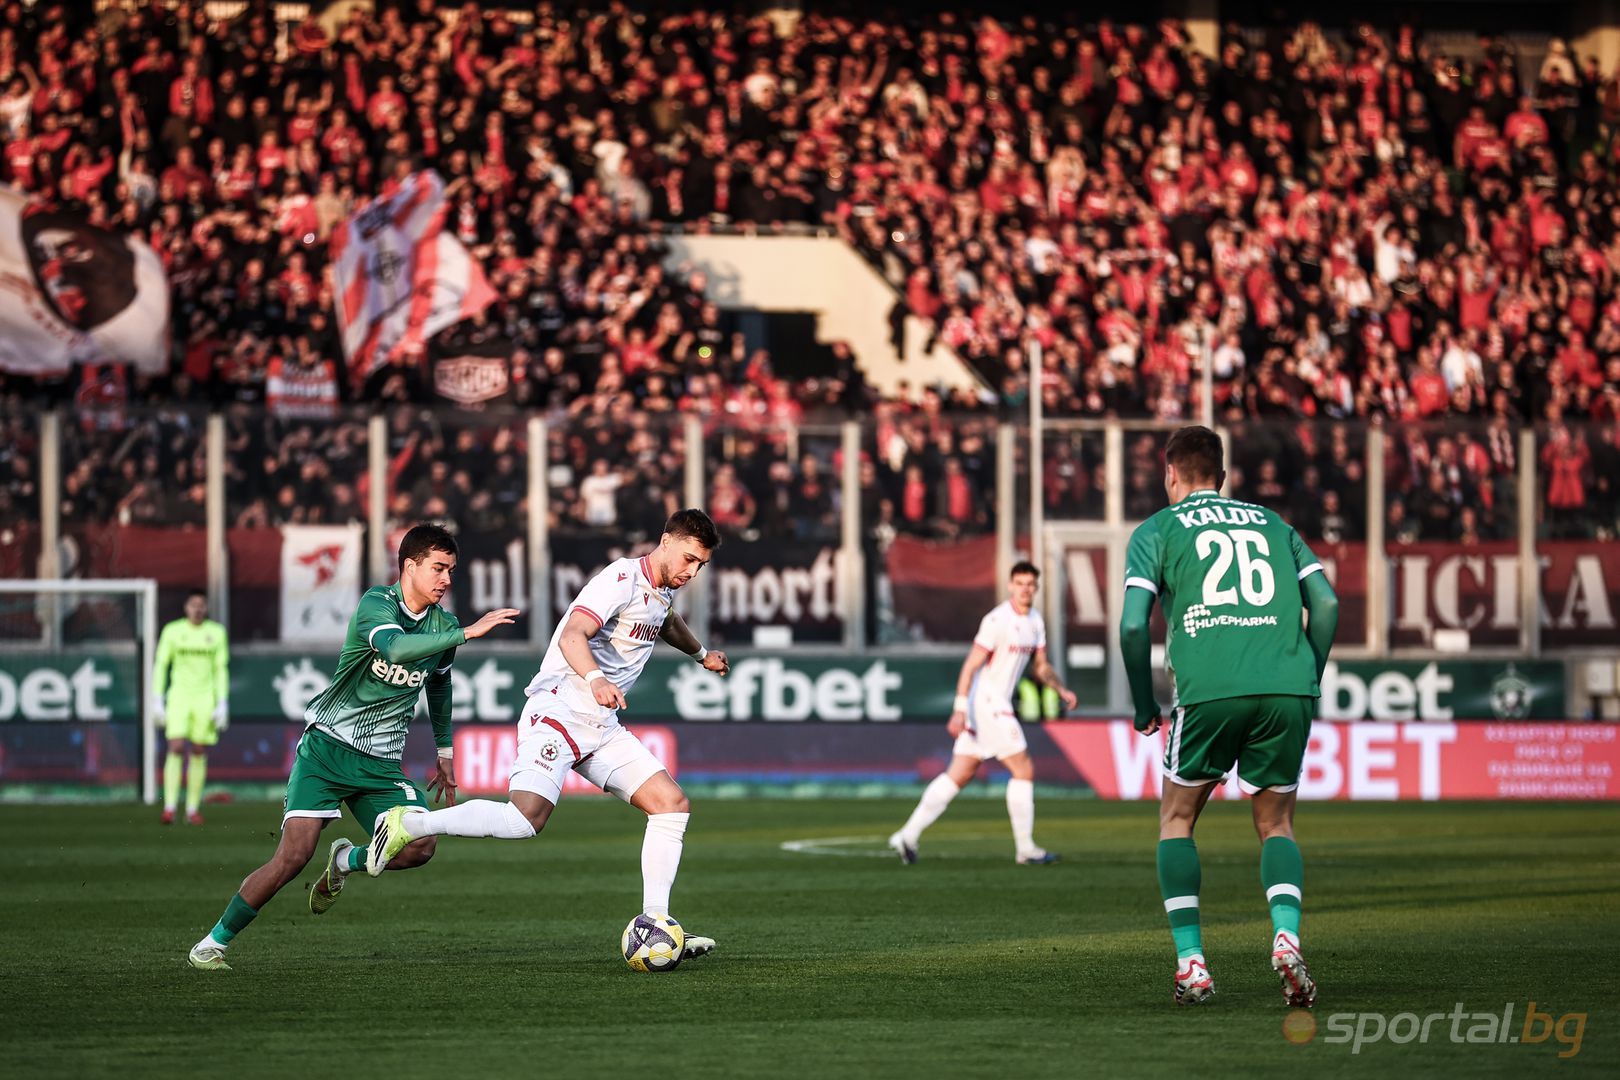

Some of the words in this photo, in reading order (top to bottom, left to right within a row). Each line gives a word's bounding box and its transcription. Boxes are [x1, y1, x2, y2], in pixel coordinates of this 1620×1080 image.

[1195, 529, 1275, 607] 26
[1196, 615, 1277, 629] HUVEPHARMA
[371, 659, 428, 687] efbet
[668, 658, 902, 720] efbet
[1318, 660, 1454, 720] bet
